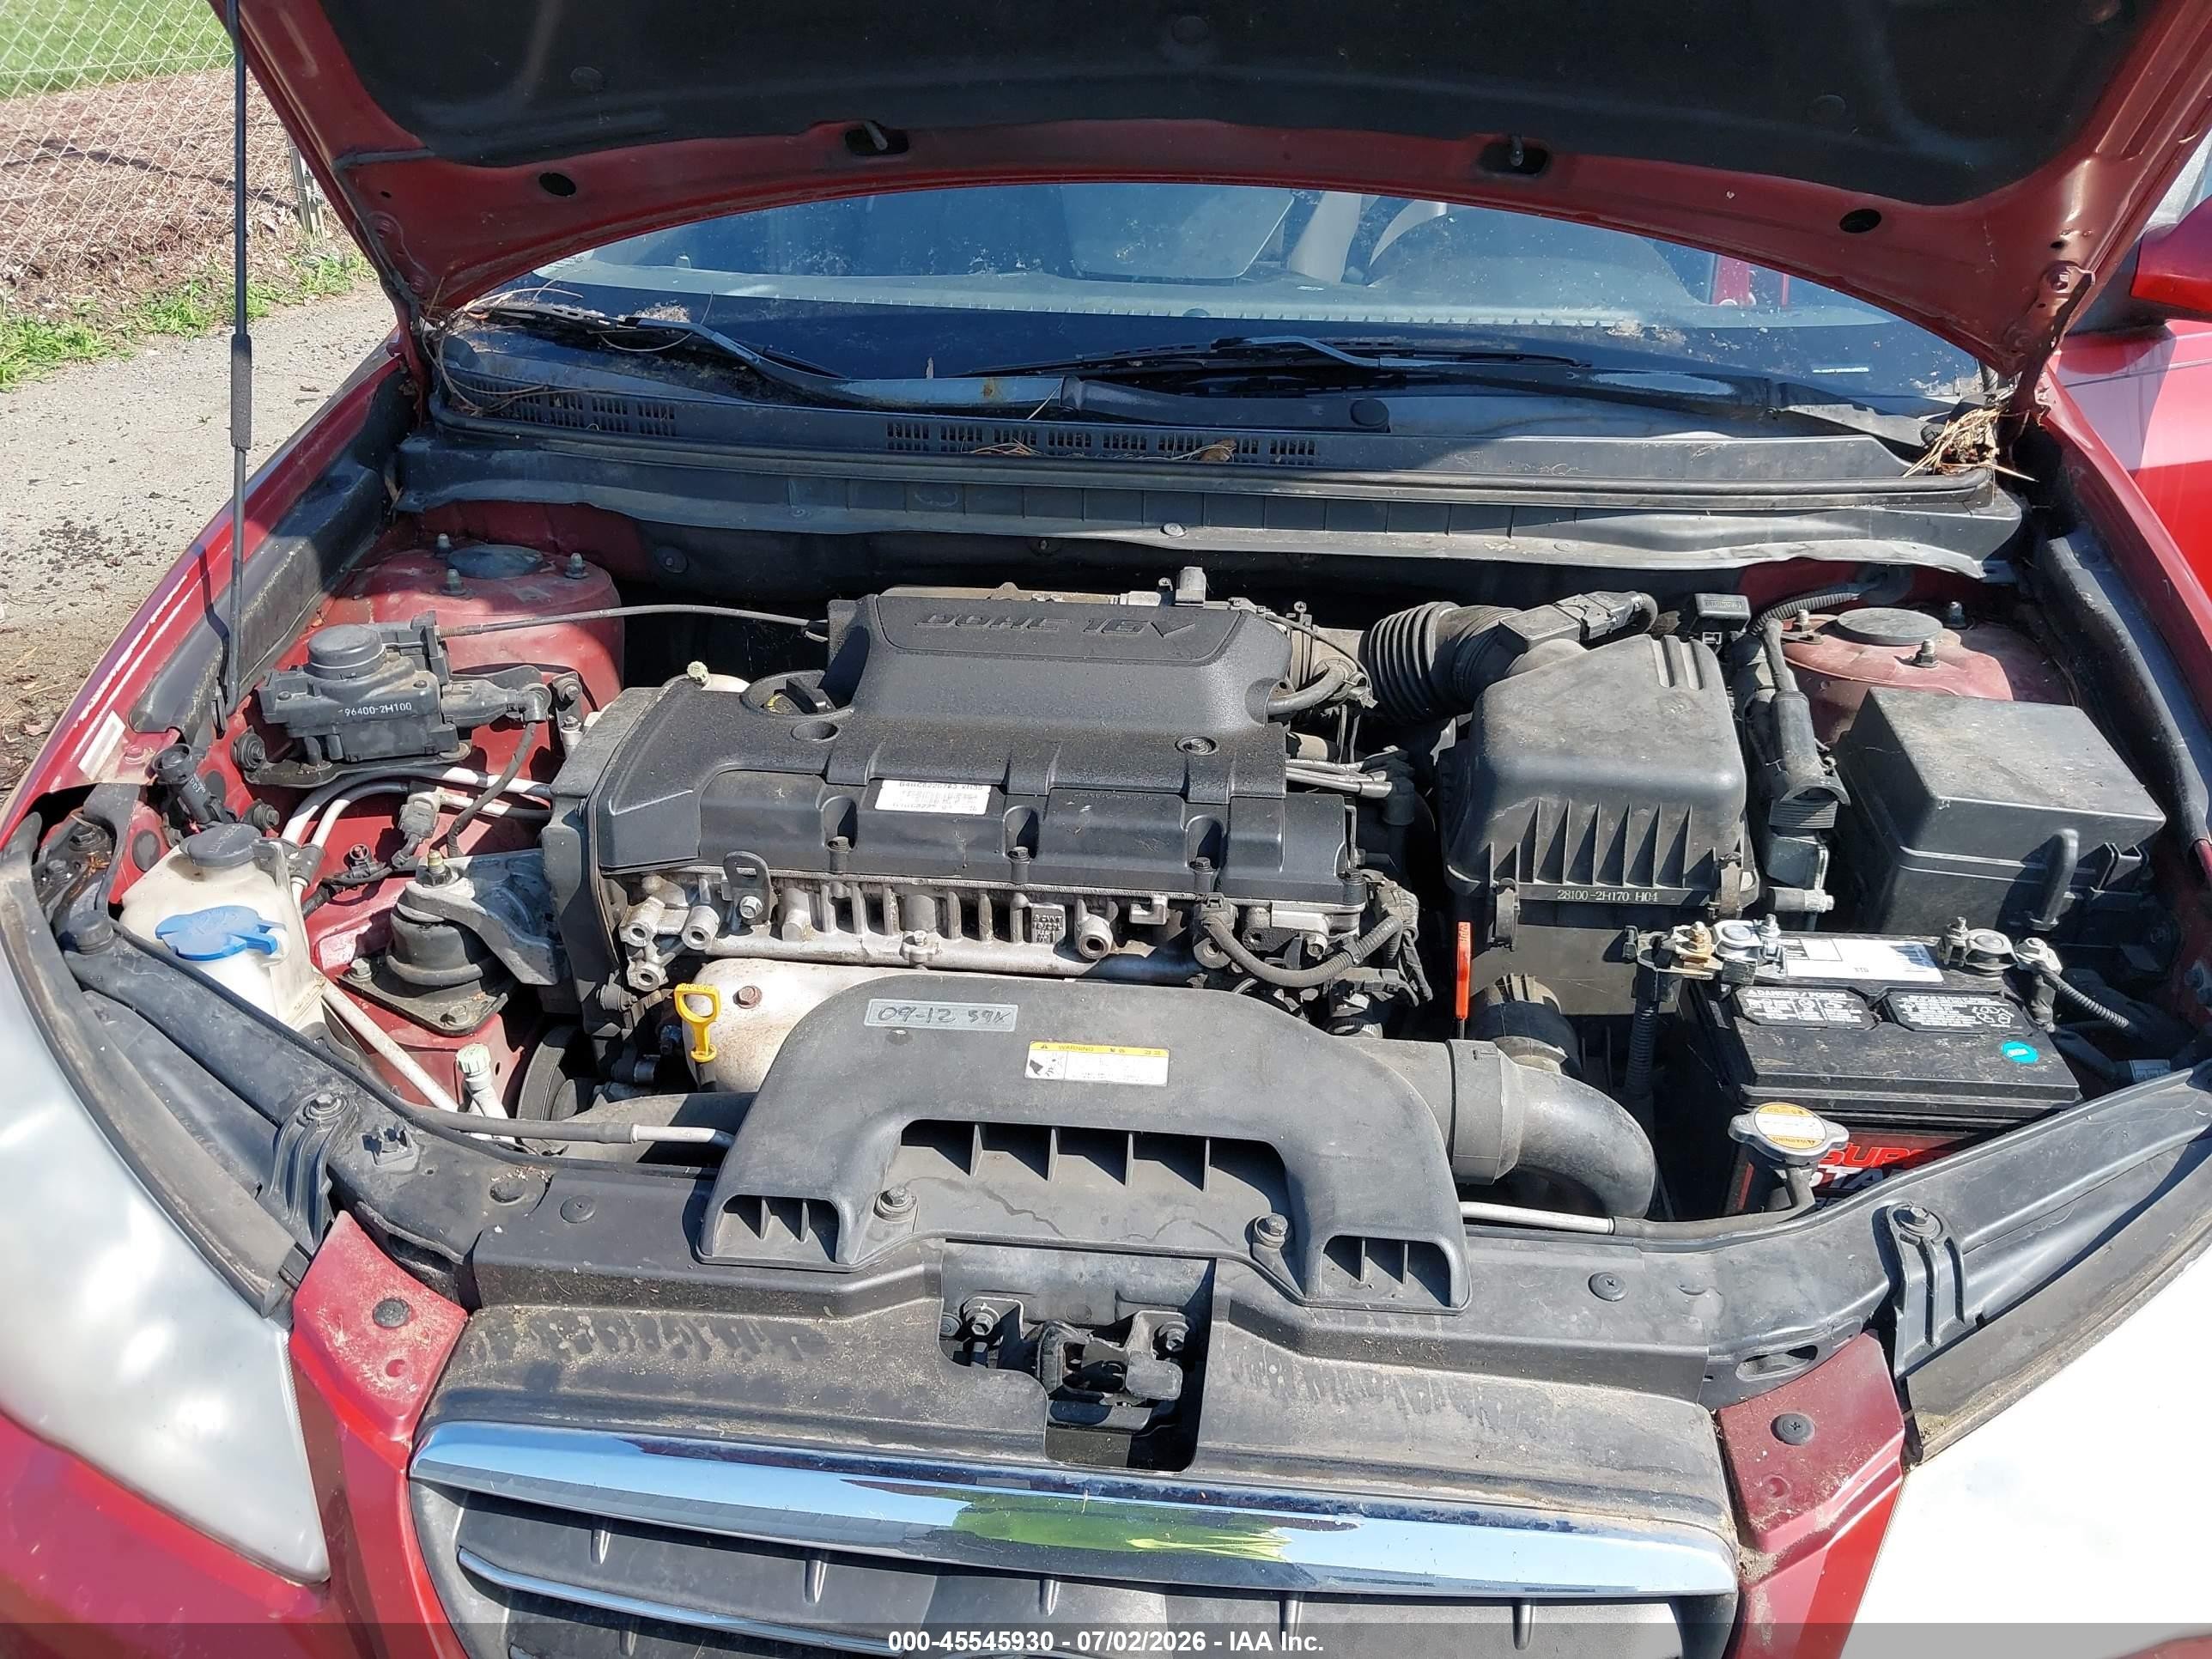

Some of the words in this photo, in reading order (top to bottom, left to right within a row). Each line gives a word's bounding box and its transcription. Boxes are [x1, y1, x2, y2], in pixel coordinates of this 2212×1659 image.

[344, 702, 412, 717] 96400-2H100
[1557, 889, 1630, 902] 28100-2H170
[1758, 989, 1800, 998] DANGER
[878, 1006, 956, 1024] 09-12
